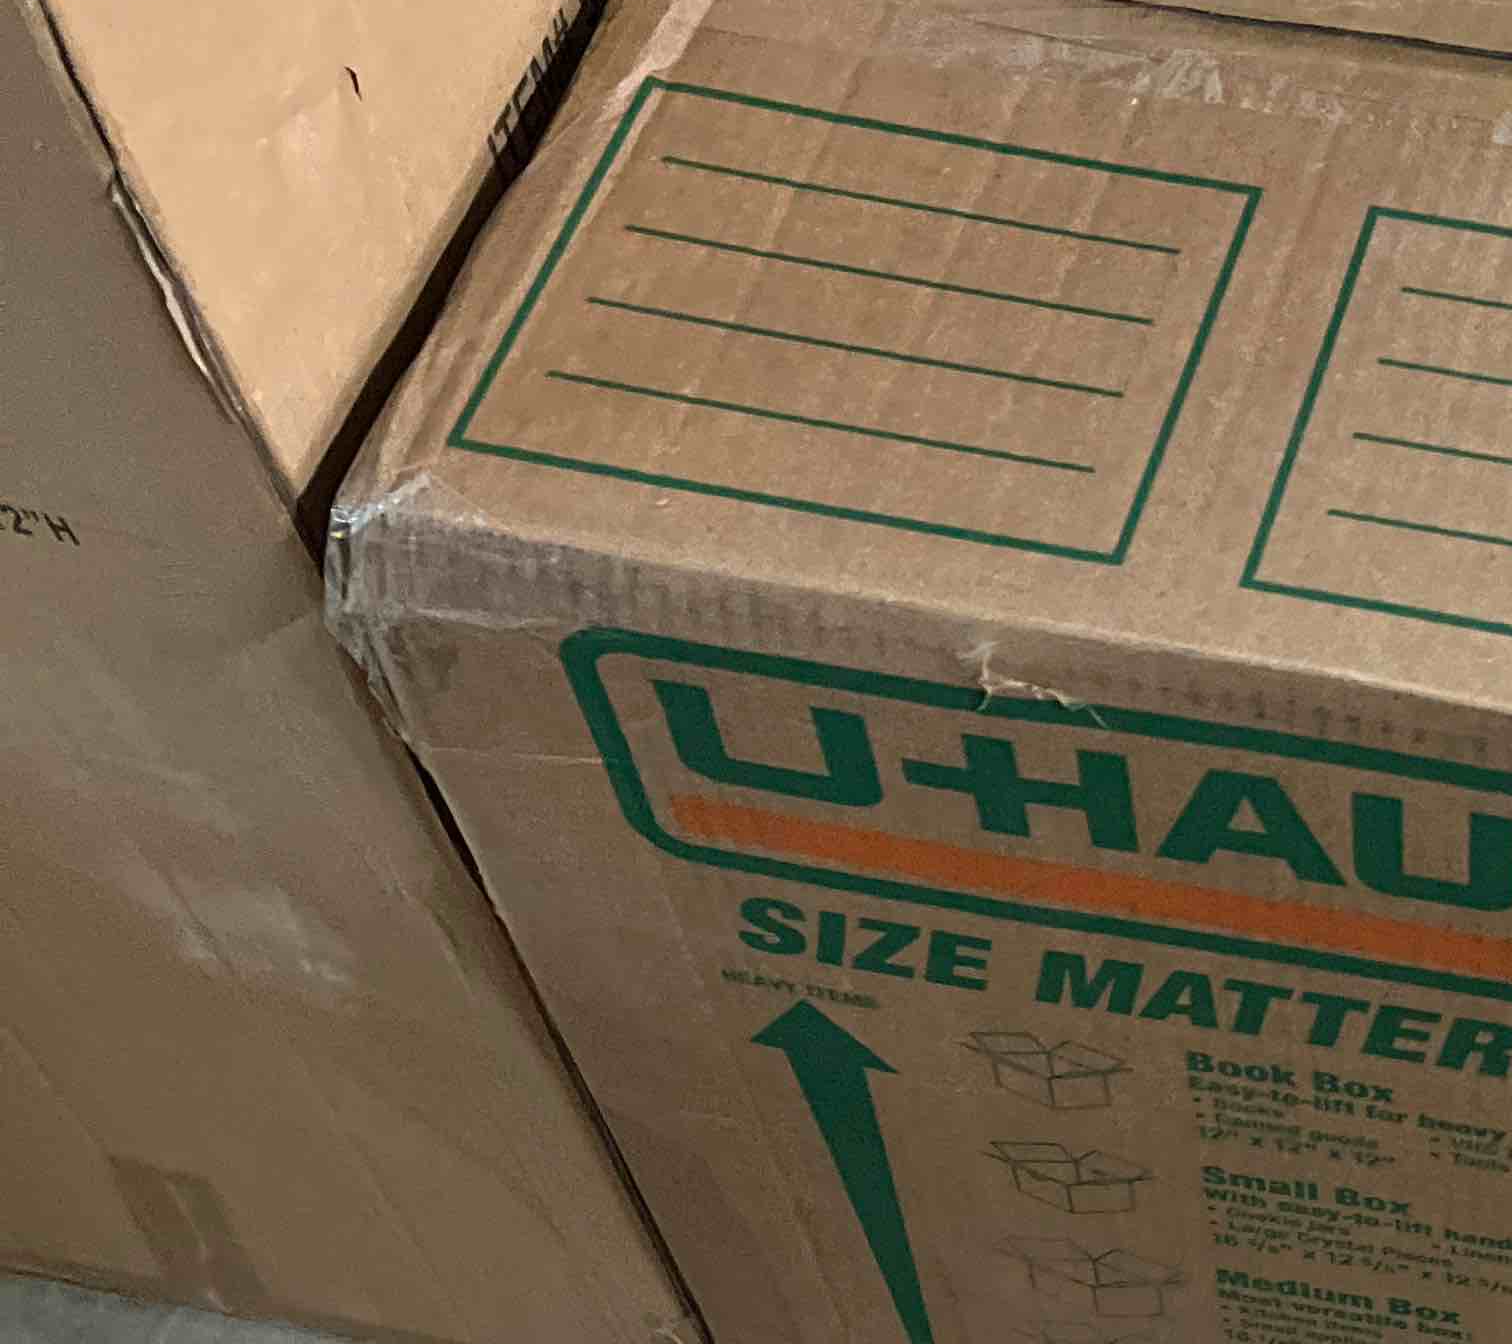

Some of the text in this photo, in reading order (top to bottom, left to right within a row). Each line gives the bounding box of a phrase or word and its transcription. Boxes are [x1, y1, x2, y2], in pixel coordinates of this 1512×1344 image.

[736, 895, 994, 993] SIZE
[1187, 1050, 1393, 1103] Book Box
[1190, 1075, 1354, 1116] Easy-to-lift
[1367, 1104, 1409, 1124] for
[1418, 1112, 1507, 1143] heavy
[1202, 1165, 1410, 1215] Small Box
[1215, 1268, 1461, 1324] Medium Box
